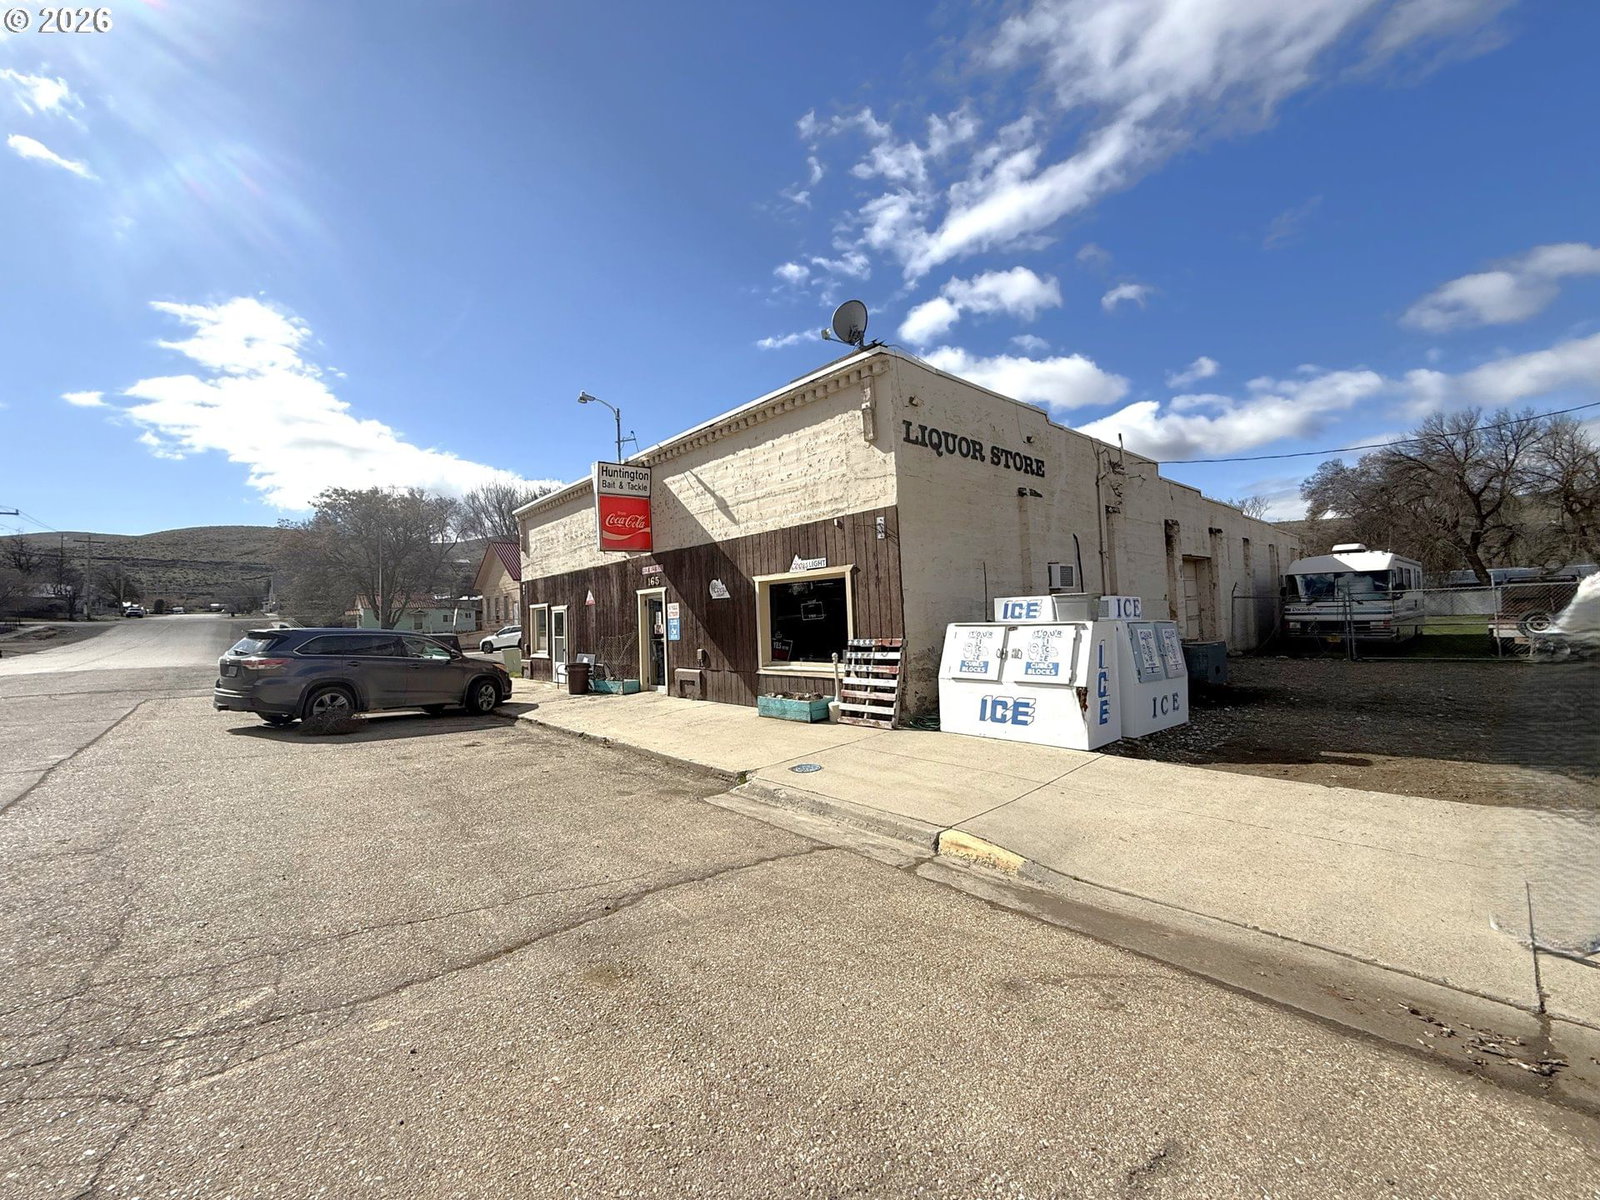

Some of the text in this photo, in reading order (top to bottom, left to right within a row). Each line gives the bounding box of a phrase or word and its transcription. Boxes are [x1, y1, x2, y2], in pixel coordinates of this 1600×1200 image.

[902, 419, 1046, 478] LIQUOR STORE
[601, 466, 649, 482] Huntington
[602, 480, 648, 491] Bait & Tackle
[809, 559, 826, 568] LIGHT
[1003, 600, 1042, 619] ICE
[1116, 598, 1141, 618] ICE
[1098, 641, 1110, 725] ICE
[979, 695, 1036, 726] ICE
[1152, 692, 1180, 719] ICE
